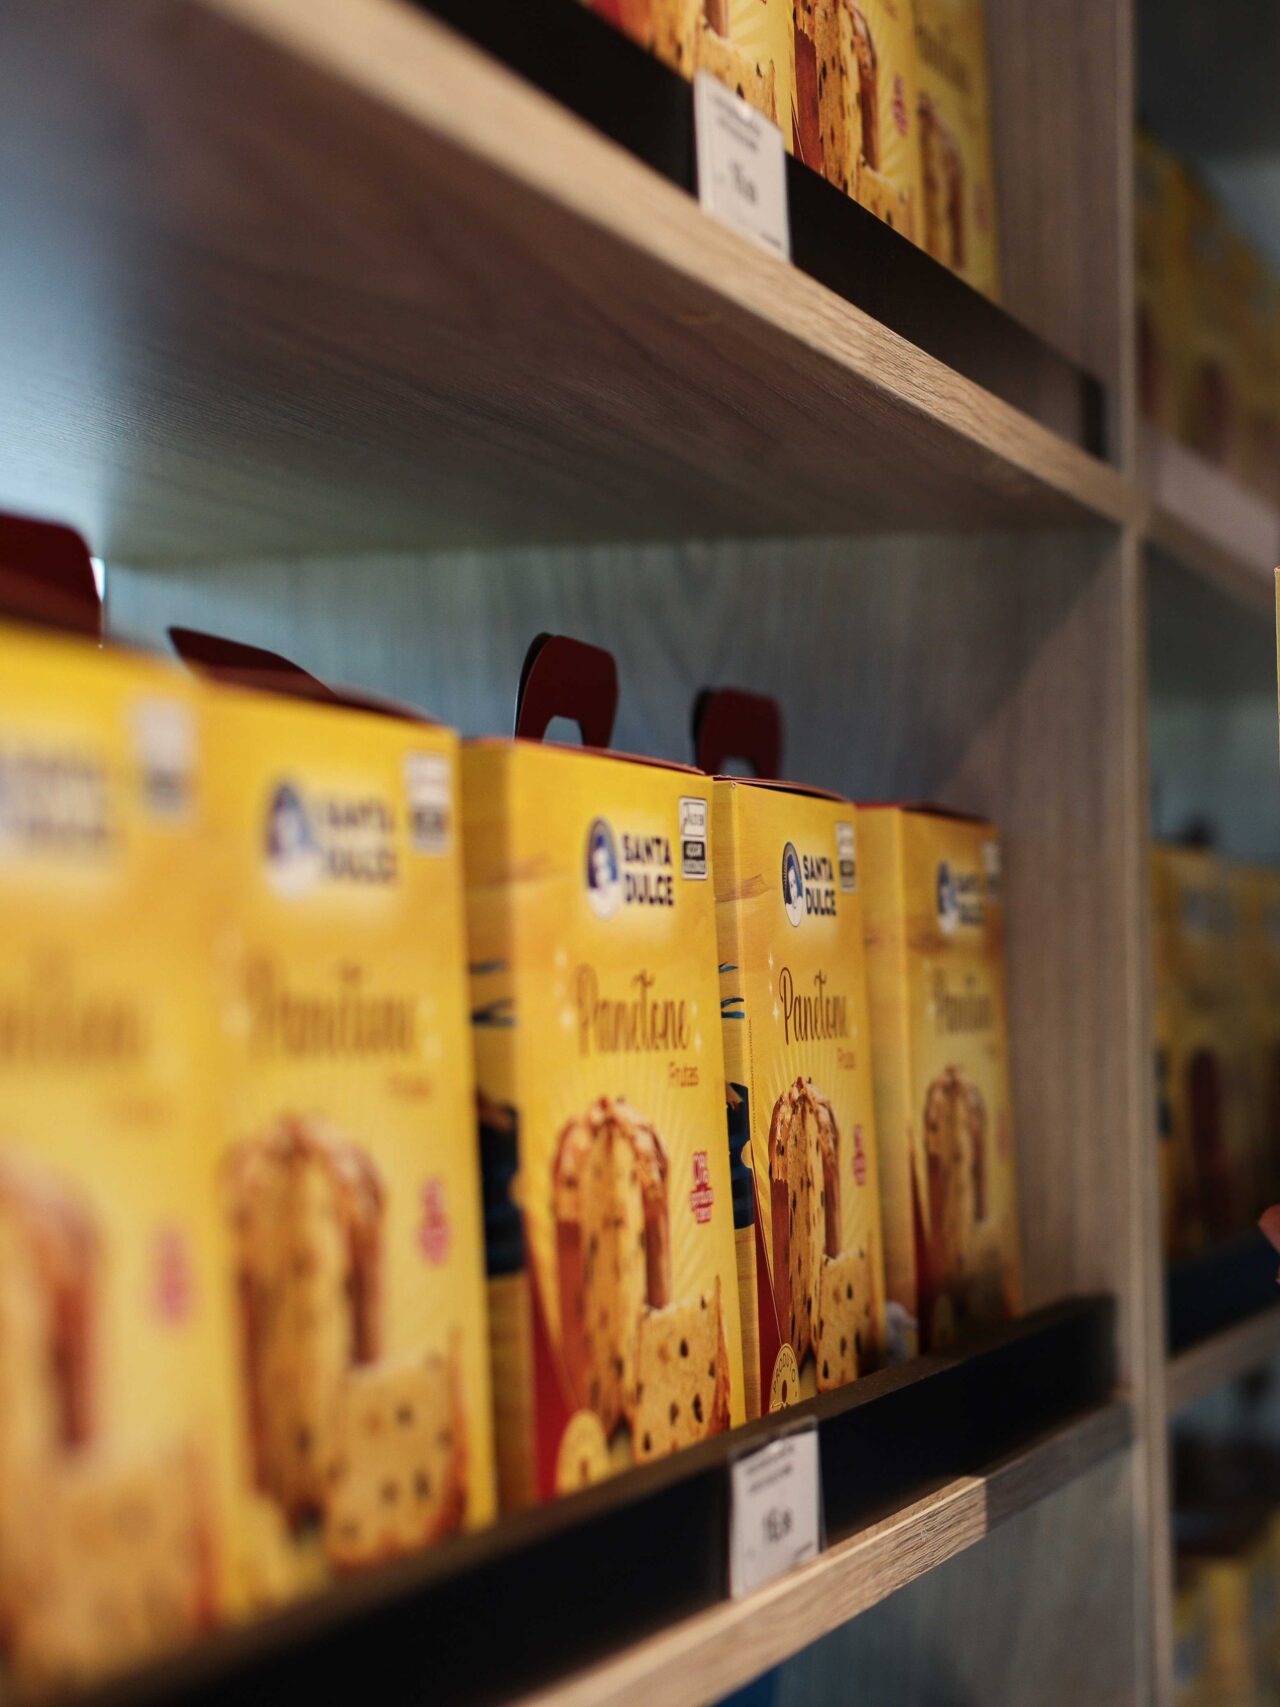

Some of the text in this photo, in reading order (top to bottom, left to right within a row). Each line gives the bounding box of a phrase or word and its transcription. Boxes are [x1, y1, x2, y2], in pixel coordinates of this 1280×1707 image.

[622, 833, 673, 865] SANTA
[803, 855, 835, 881] SANTA
[624, 873, 674, 907] DULCE
[805, 887, 837, 916] DULCE
